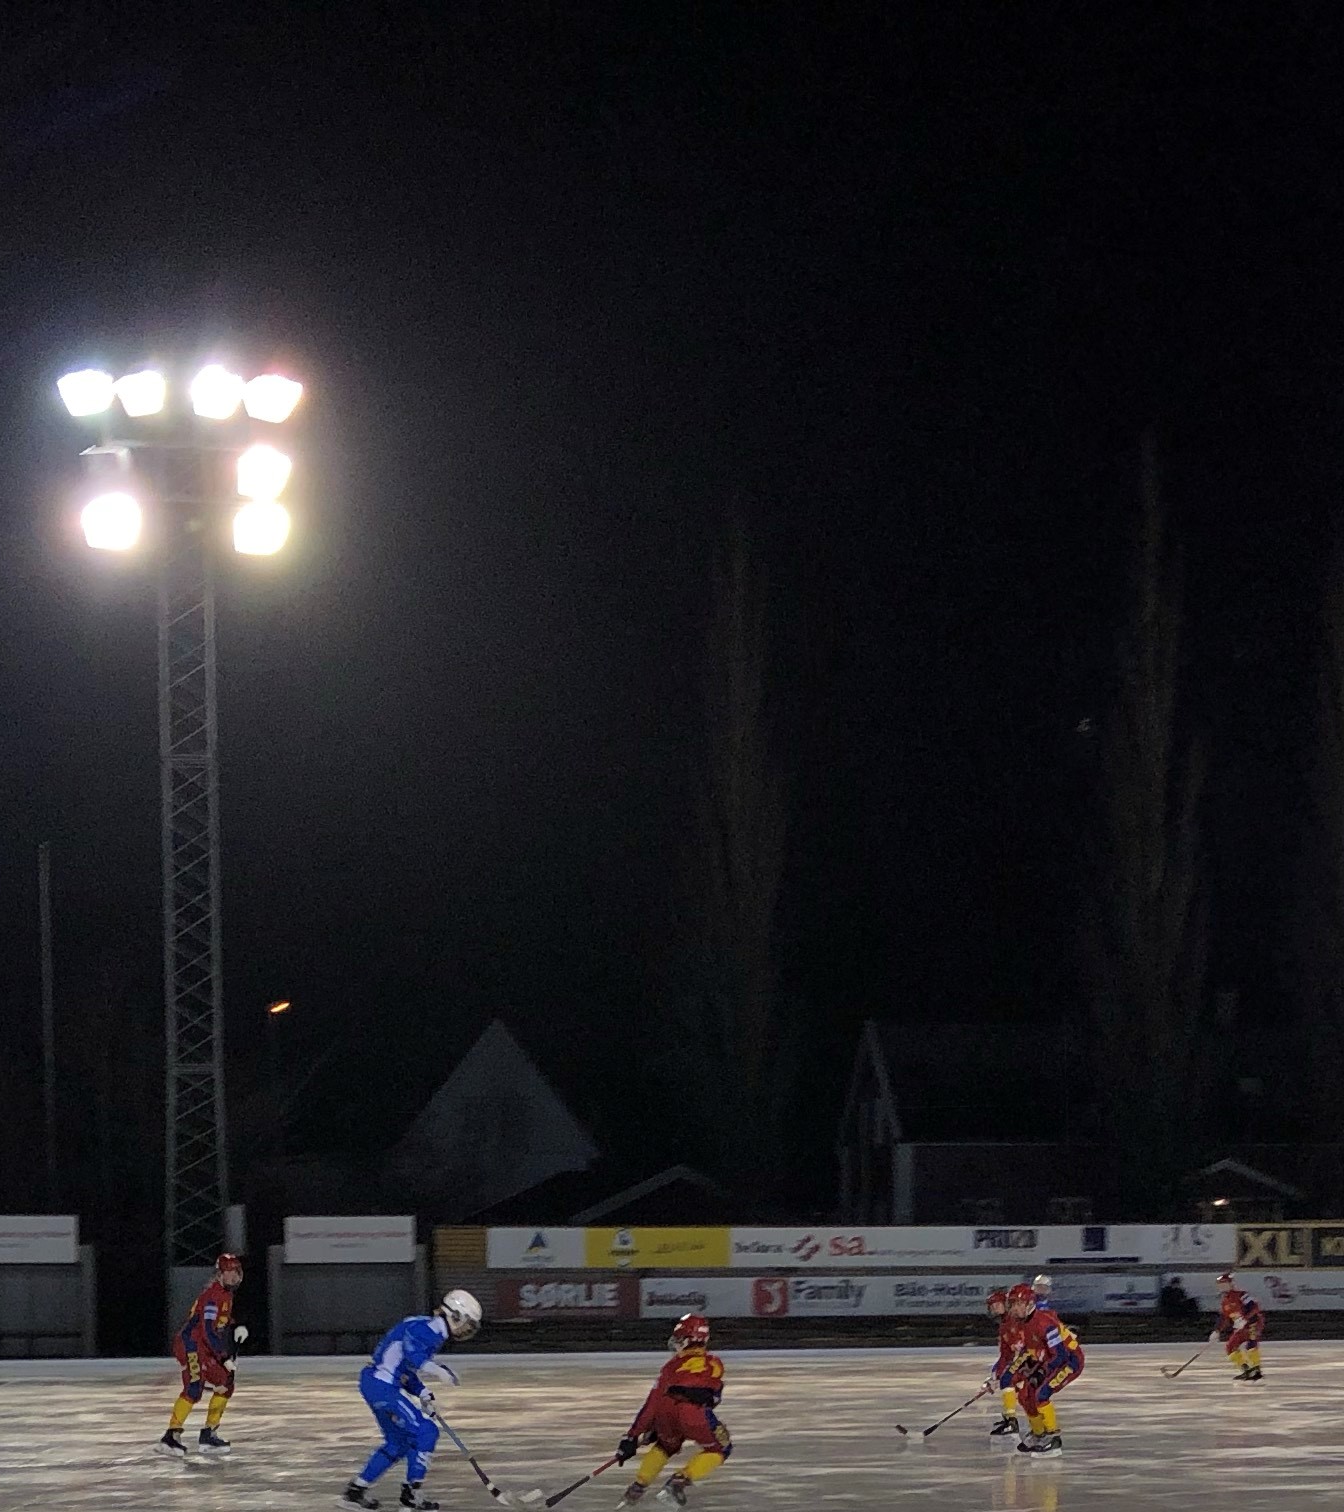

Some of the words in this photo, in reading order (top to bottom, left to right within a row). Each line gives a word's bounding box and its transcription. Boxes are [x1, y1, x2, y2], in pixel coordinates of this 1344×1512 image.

[1238, 1228, 1303, 1265] XL
[519, 1282, 621, 1308] SØRLIE
[791, 1279, 867, 1308] Family
